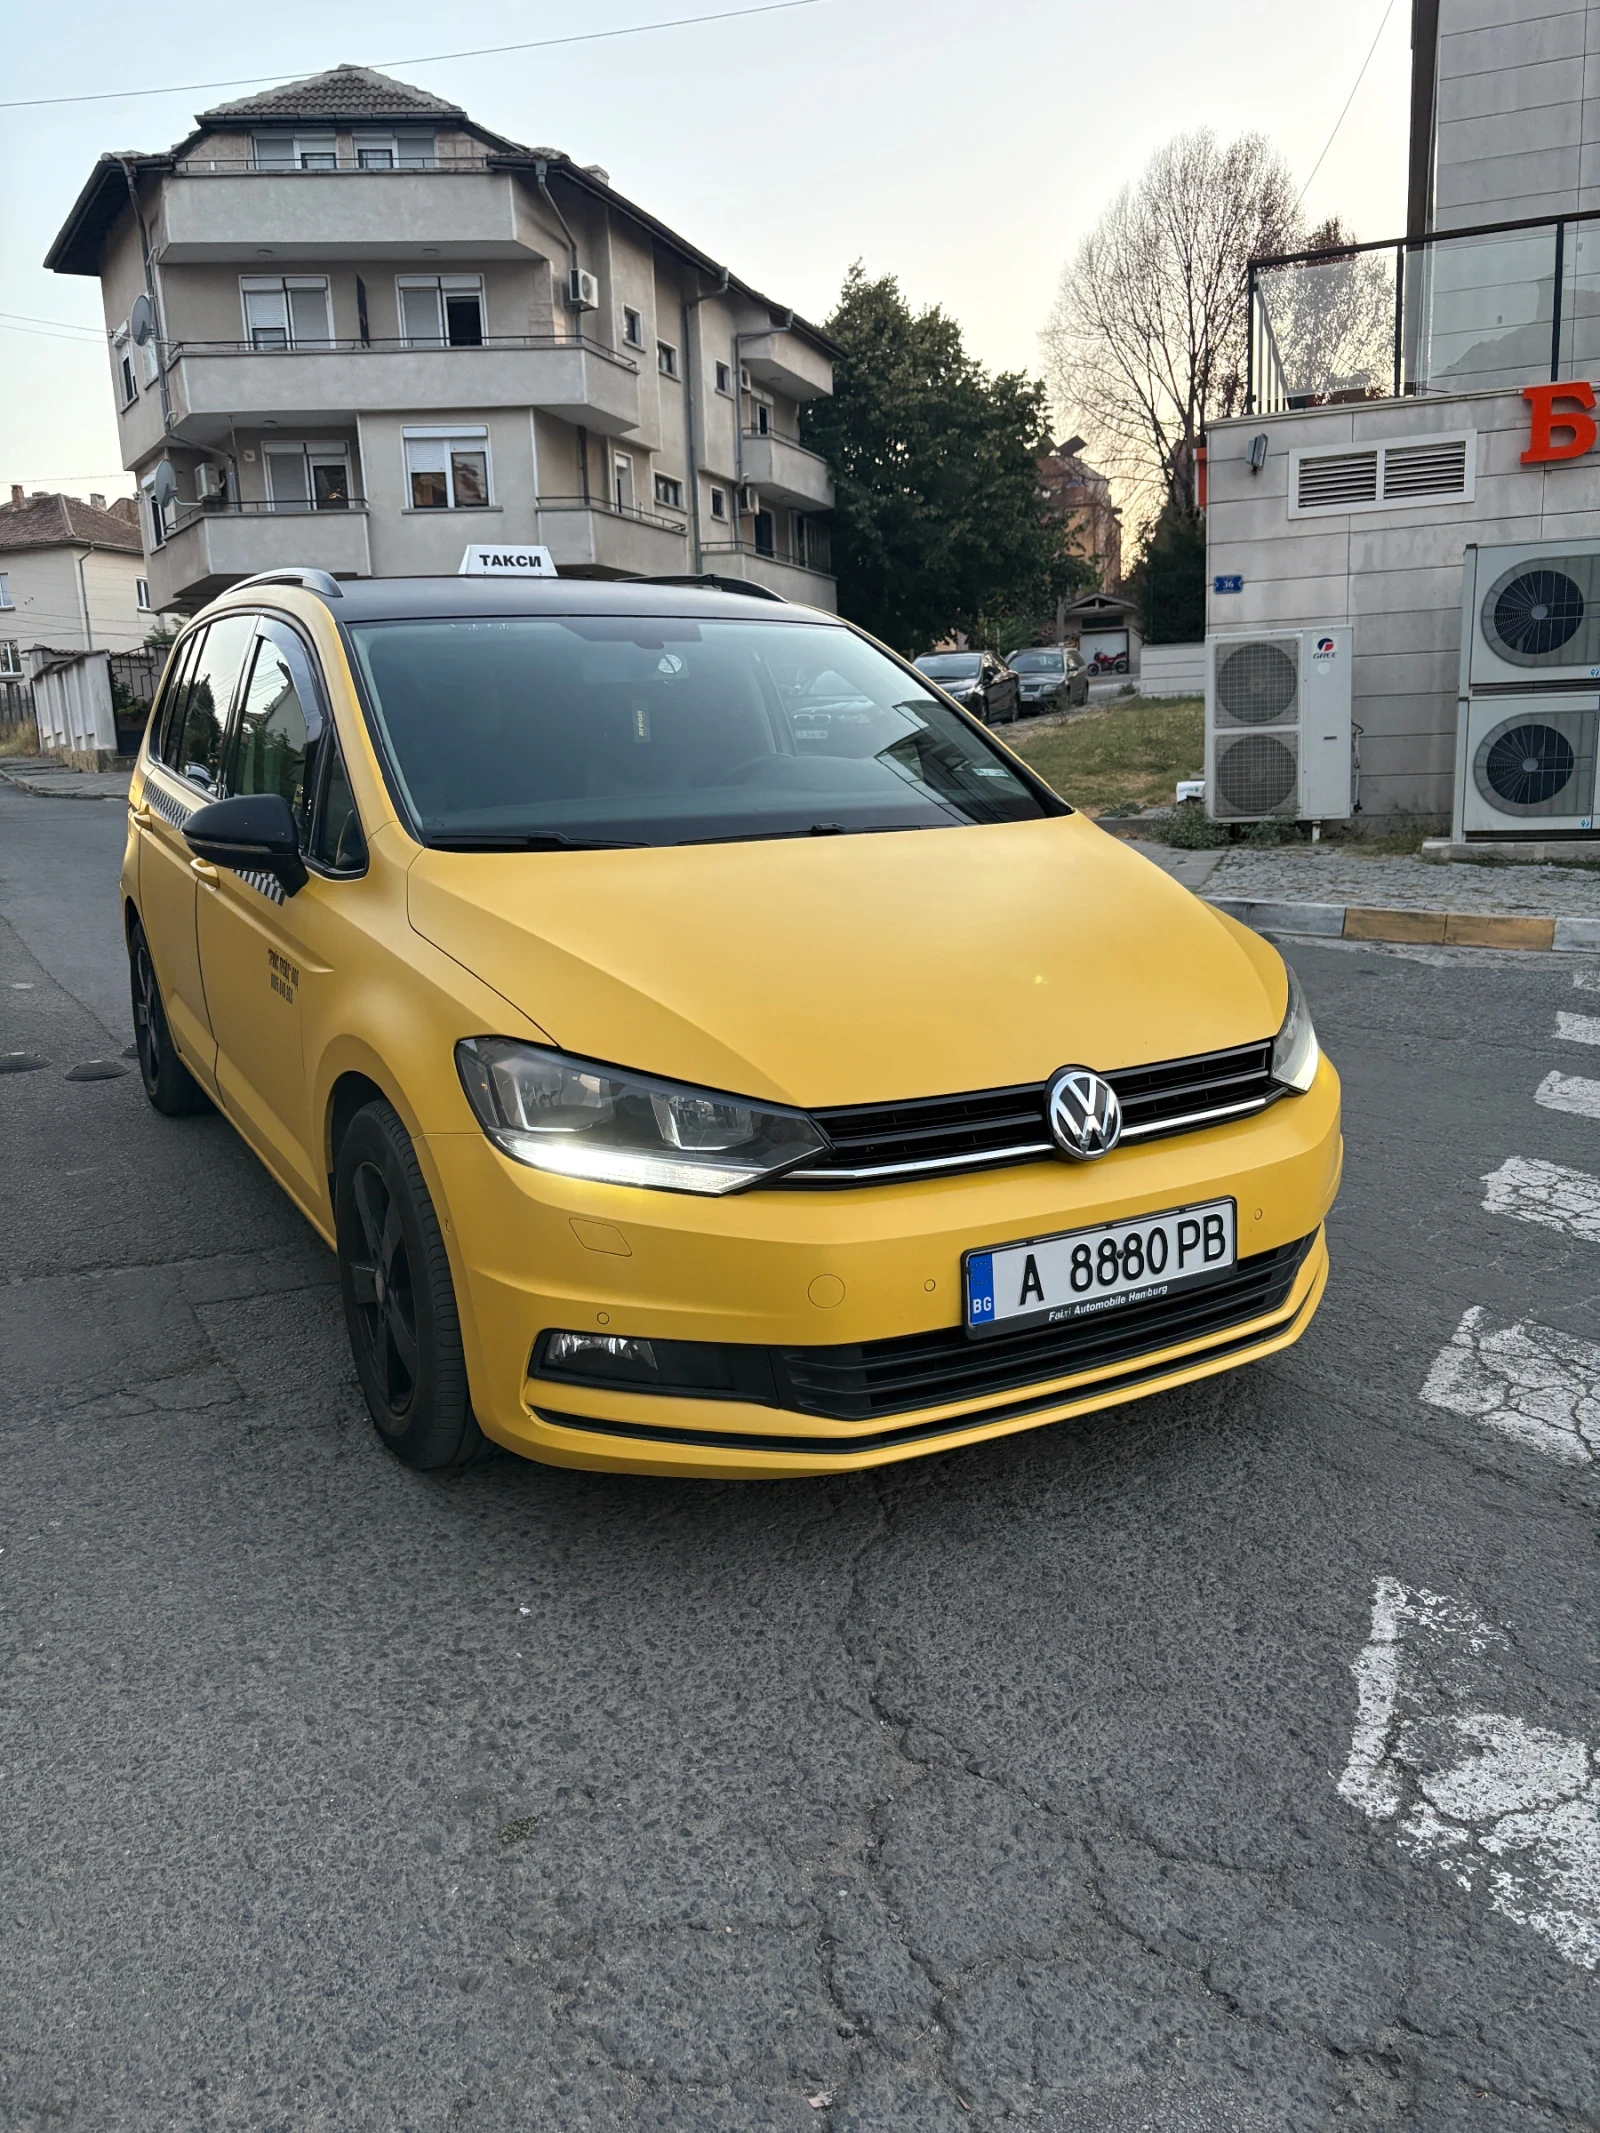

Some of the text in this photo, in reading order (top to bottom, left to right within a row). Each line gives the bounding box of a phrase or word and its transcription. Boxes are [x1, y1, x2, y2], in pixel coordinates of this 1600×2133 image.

[1520, 381, 1597, 465] Б
[479, 554, 542, 568] ТАКСИ
[1223, 580, 1234, 589] 36
[1019, 1253, 1045, 1306] A
[1070, 1226, 1168, 1292] 8880
[973, 1296, 992, 1314] BG
[1074, 1296, 1126, 1315] Automobile
[1128, 1285, 1168, 1302] Hamburg
